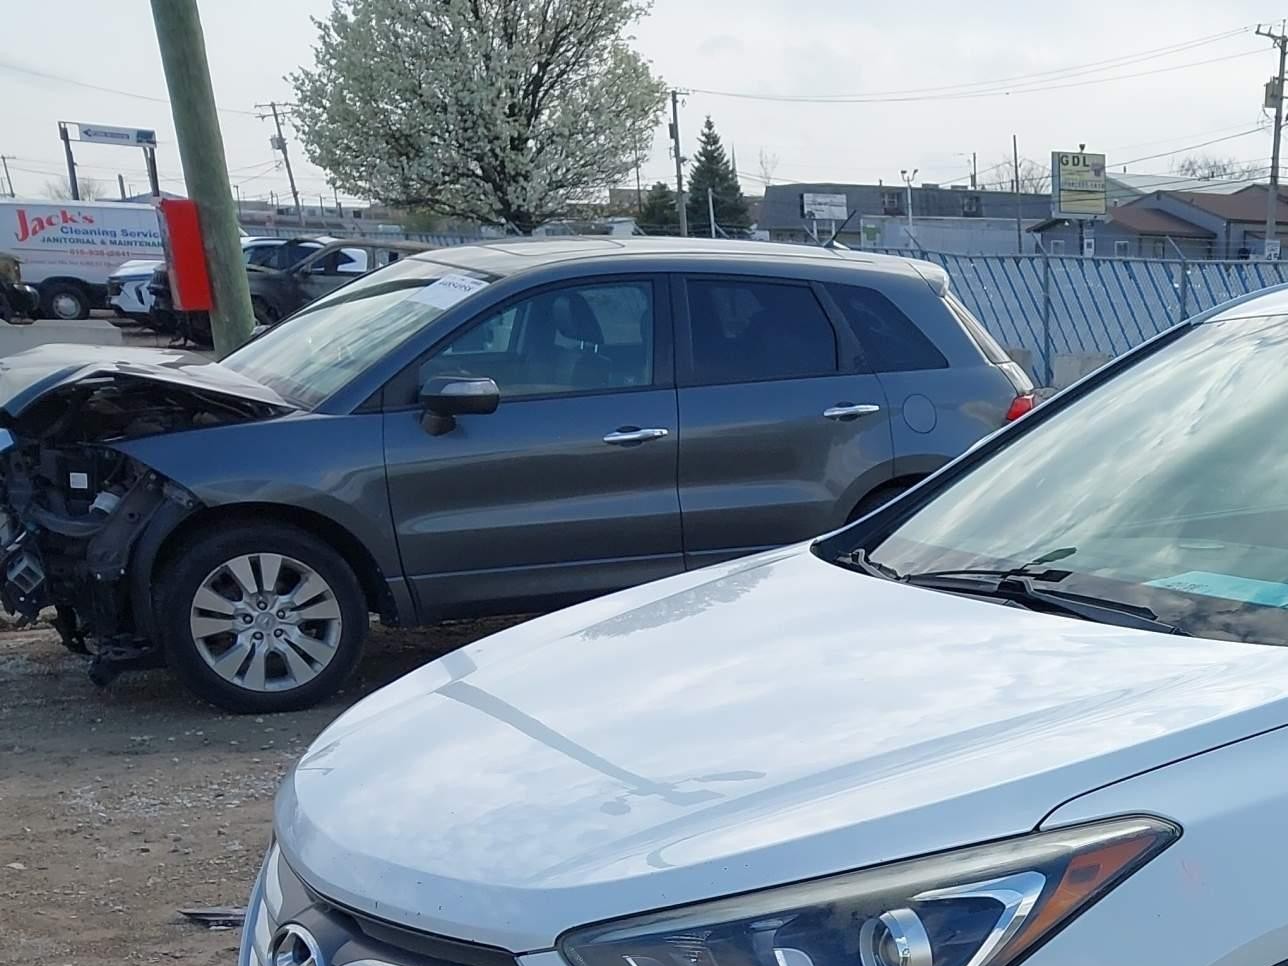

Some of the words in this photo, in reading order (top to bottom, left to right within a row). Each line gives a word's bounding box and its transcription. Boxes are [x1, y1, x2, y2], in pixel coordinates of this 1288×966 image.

[1060, 154, 1089, 167] GDL
[15, 208, 95, 242] Jack's
[60, 226, 117, 238] Cleaning
[121, 229, 160, 239] Servic
[41, 236, 96, 246] JANITORIAL
